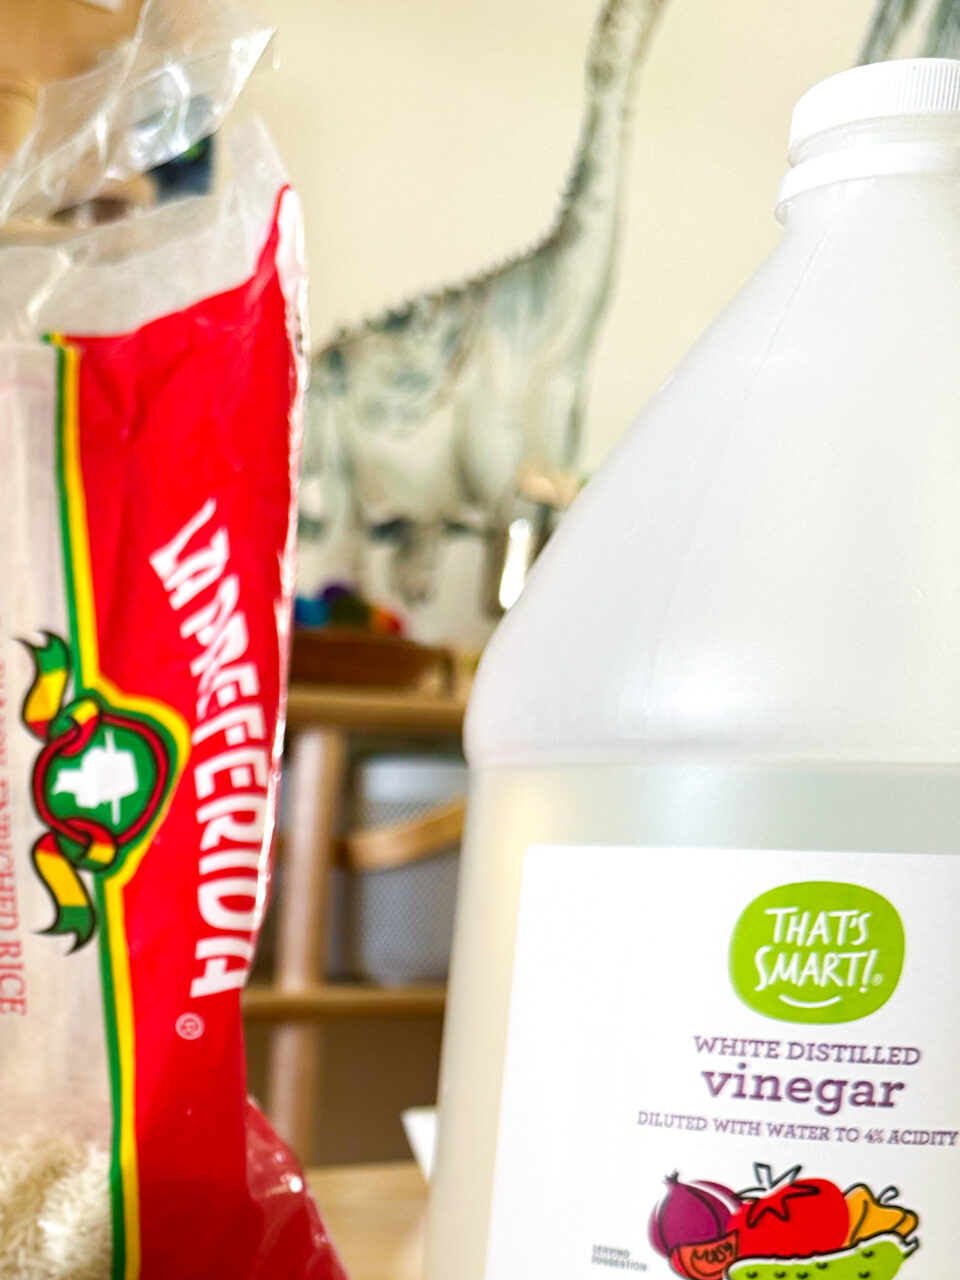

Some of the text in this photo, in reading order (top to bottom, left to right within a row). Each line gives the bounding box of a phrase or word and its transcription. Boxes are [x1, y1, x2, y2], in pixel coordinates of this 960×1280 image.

[149, 498, 269, 999] LA PREFERIDA
[764, 906, 872, 948] THAT'S
[693, 1035, 921, 1066] WHITE DISTILLED
[701, 1062, 904, 1116] vinegar
[637, 1110, 959, 1147] DILUTED WITH WATER TO 4% ACIDITY
